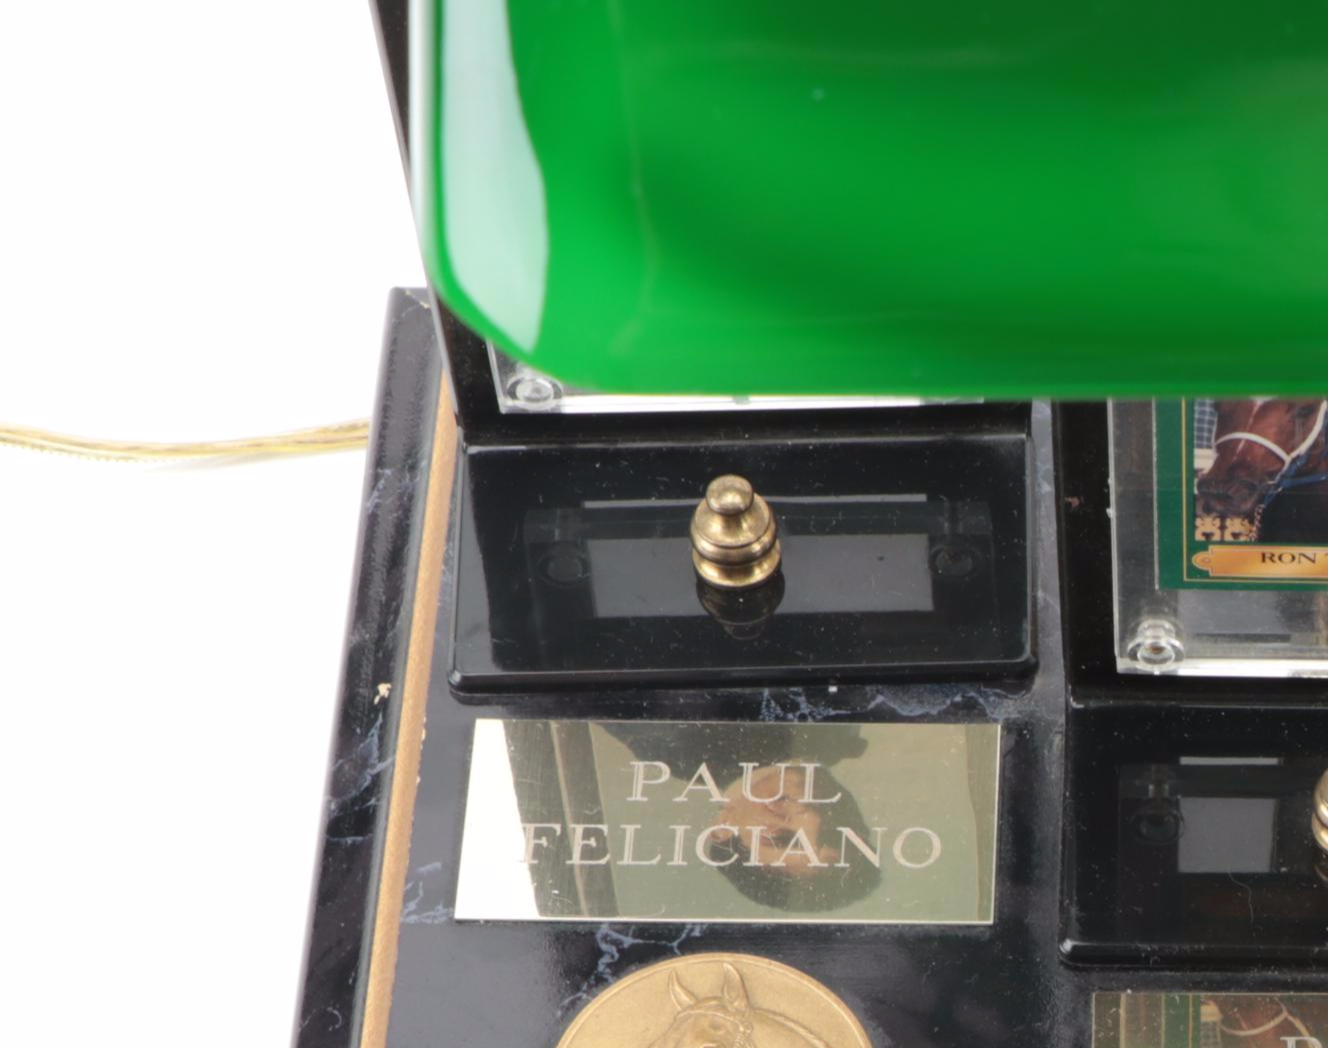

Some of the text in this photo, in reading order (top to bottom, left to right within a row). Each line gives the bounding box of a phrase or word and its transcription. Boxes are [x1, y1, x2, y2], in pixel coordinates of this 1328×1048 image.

[1260, 551, 1316, 564] RON
[626, 760, 842, 804] PAUL
[518, 822, 943, 869] FELICIANO
